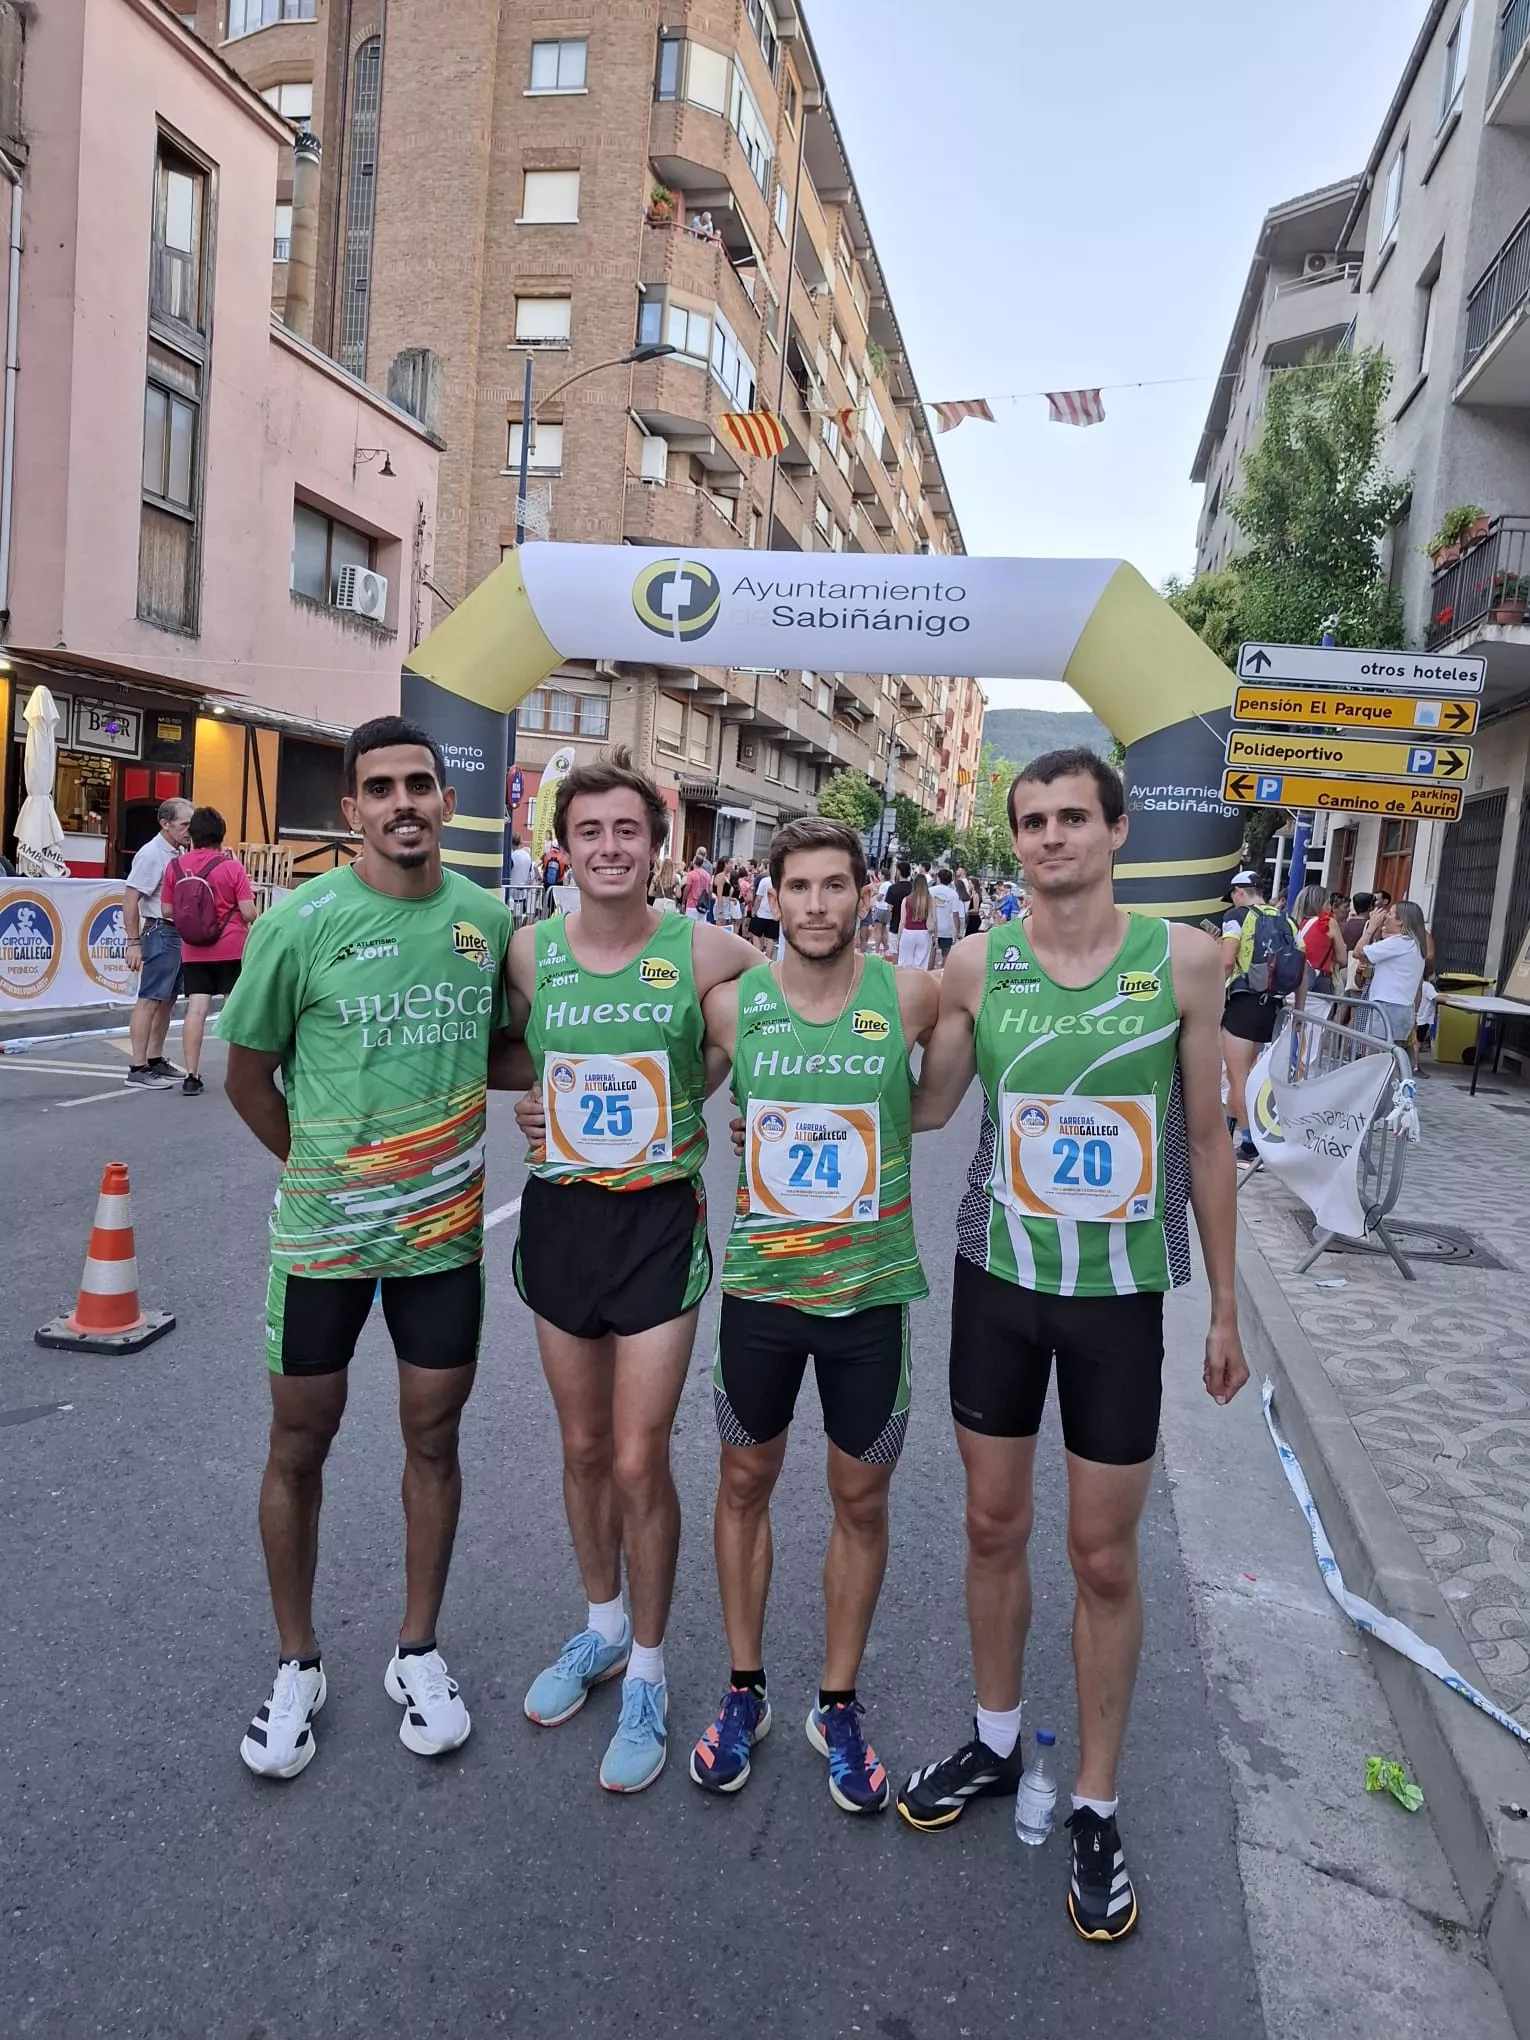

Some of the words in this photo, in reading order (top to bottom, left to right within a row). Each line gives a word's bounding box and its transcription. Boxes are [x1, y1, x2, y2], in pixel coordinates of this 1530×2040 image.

[732, 577, 966, 602] Ayuntamiento
[772, 605, 970, 637] Sabiñánigo
[1360, 662, 1405, 678] otros
[1413, 664, 1478, 682] hoteles
[1239, 698, 1302, 714] pensión
[1310, 700, 1326, 715] El
[1335, 702, 1392, 719] Parque
[1233, 741, 1343, 762] Polideportivo
[1411, 750, 1432, 772] P
[1261, 779, 1278, 798] P
[1411, 788, 1458, 802] parking
[1143, 798, 1240, 818] Sabiñánigo
[1317, 793, 1380, 811] Camino
[1385, 798, 1405, 812] de
[1411, 800, 1456, 816] Aurín
[2, 936, 42, 946] CIRCUITO
[356, 937, 397, 948] ATLETISMO
[356, 945, 399, 961] ZOITI
[538, 955, 567, 967] VIATOR
[993, 962, 1030, 971] VIATOR
[552, 973, 579, 987] ZOITI
[1010, 977, 1041, 985] ATLETISMO
[1009, 984, 1040, 994] ZOITI
[743, 1002, 777, 1014] VIATOR
[545, 1001, 674, 1031] Huesca
[998, 1008, 1145, 1035] Huesca
[762, 1022, 792, 1035] ZOITI
[753, 1050, 886, 1077] Huesca
[585, 1074, 616, 1082] CARRERAS
[585, 1080, 637, 1092] ALTOGALLEGO
[580, 1094, 633, 1137] 25
[1059, 1116, 1095, 1125] CARRERAS
[796, 1122, 827, 1132] CARRERAS
[1059, 1125, 1119, 1136] ALTOGALLEGO
[794, 1131, 847, 1141] ALTOGALLEGO
[788, 1143, 842, 1188] 24
[1052, 1138, 1112, 1187] 20
